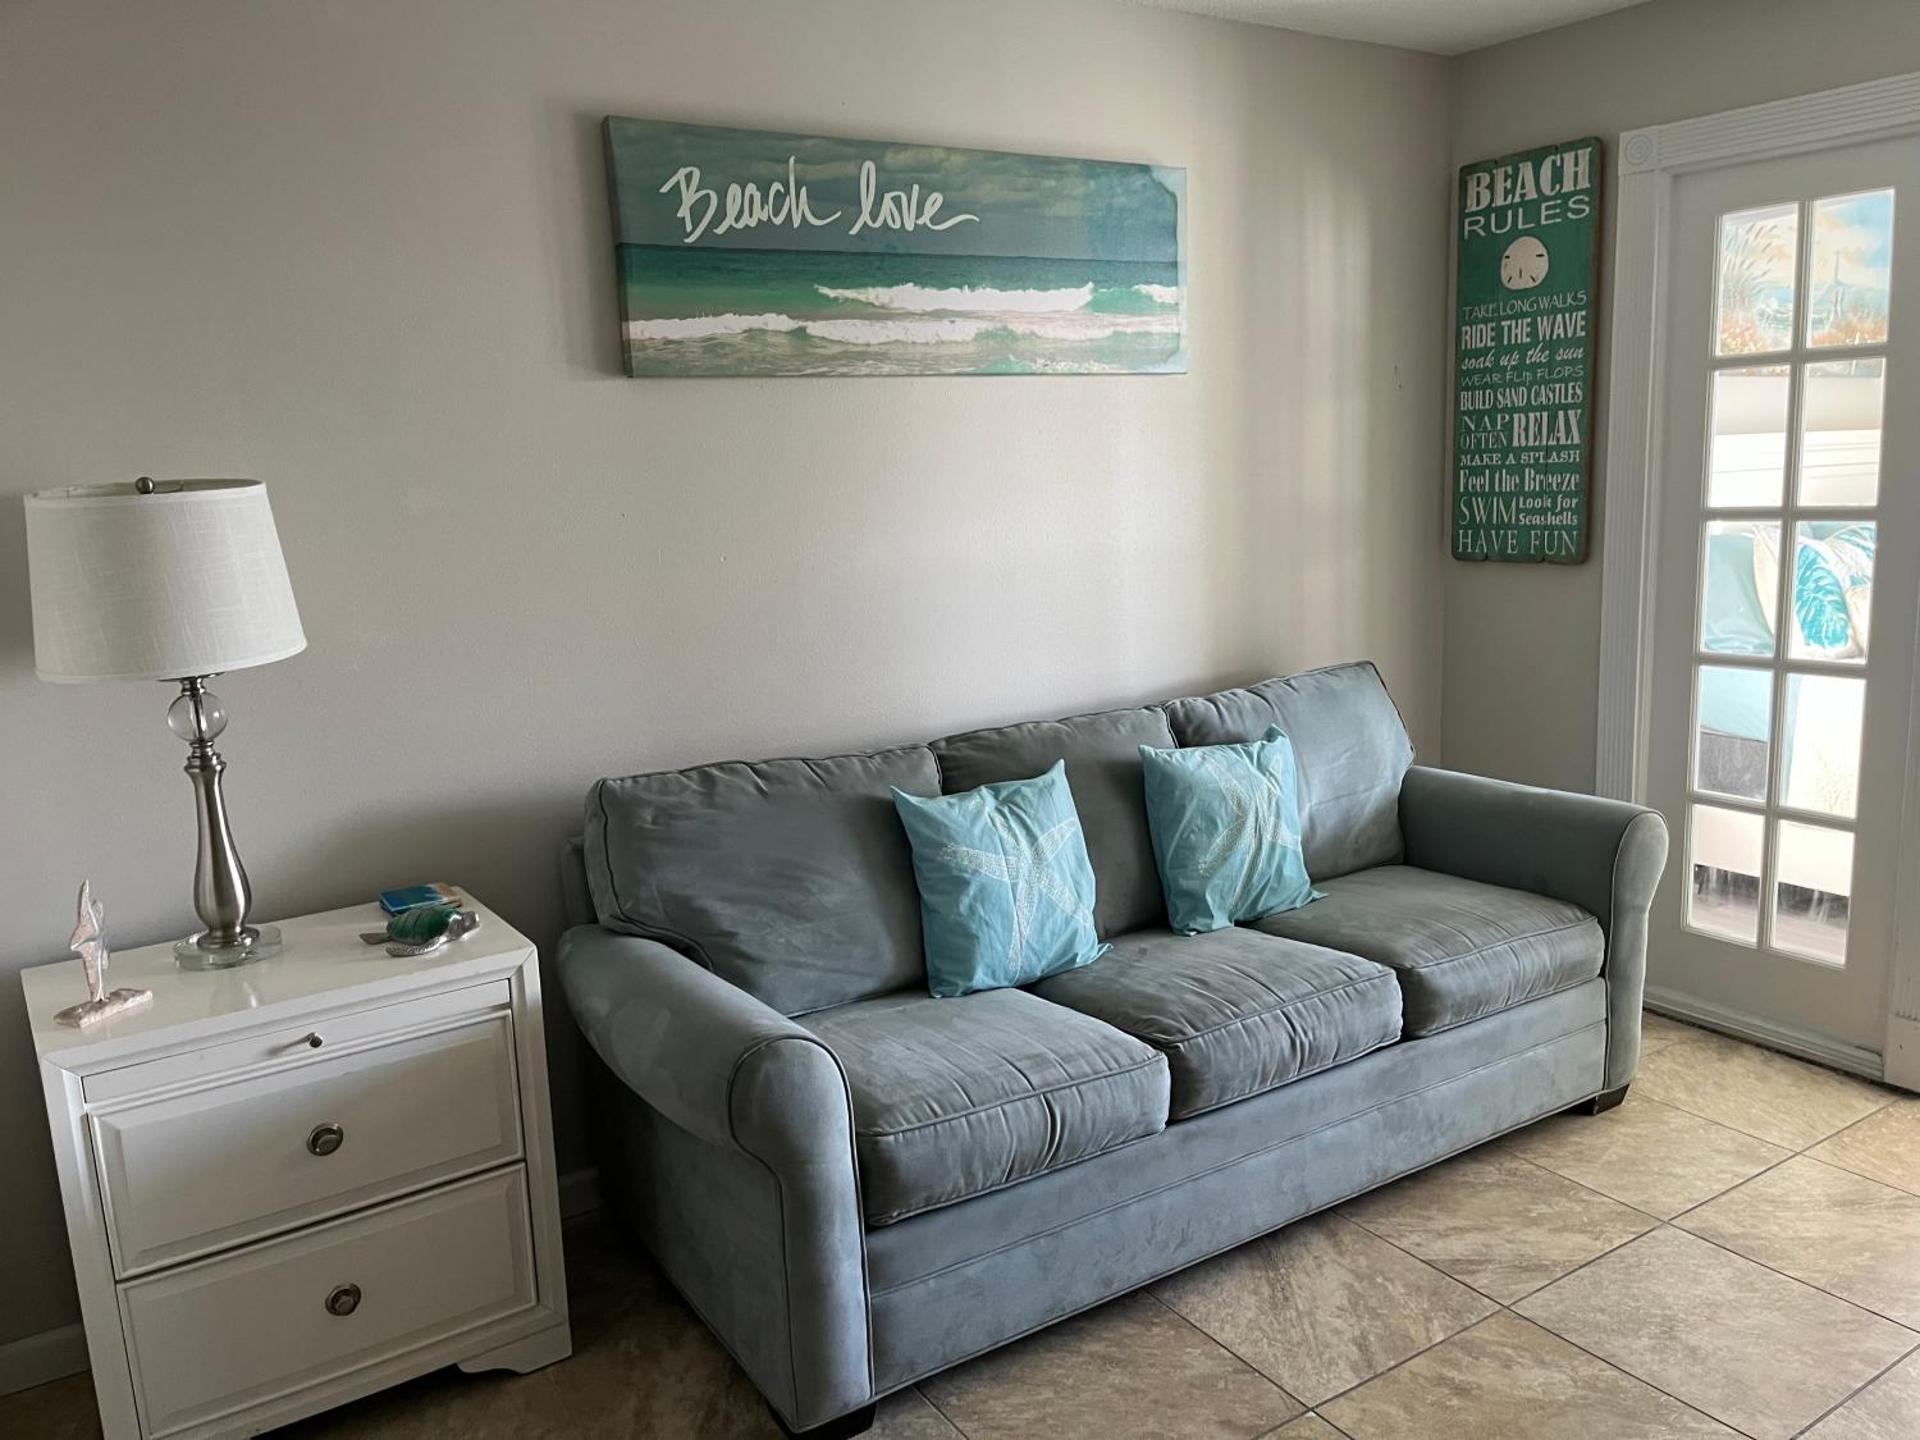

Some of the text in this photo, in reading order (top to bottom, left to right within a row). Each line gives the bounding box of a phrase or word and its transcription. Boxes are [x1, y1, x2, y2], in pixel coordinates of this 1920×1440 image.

[1465, 147, 1592, 213] BEACH
[659, 155, 980, 243] Beach love
[1464, 195, 1590, 239] RULES
[1463, 290, 1587, 319] TAKE LONG WALKS
[1461, 310, 1587, 350] RIDE THE WAVE
[1461, 342, 1584, 371] soak up the sun
[1461, 373, 1502, 387] WEAR
[1537, 365, 1584, 380] FLOPS
[1460, 382, 1583, 411] BUILD SAND CASTLES
[1461, 413, 1510, 431] NAP
[1512, 409, 1582, 447] RELAX
[1460, 432, 1507, 450] OFTEN
[1460, 450, 1580, 466] MAKE A SPLASH
[1460, 467, 1580, 492] Feel the Breeze
[1459, 496, 1517, 525] SWIM
[1519, 494, 1579, 512] Look for
[1518, 511, 1578, 526] Seashells
[1458, 529, 1578, 555] HAVE FUN
